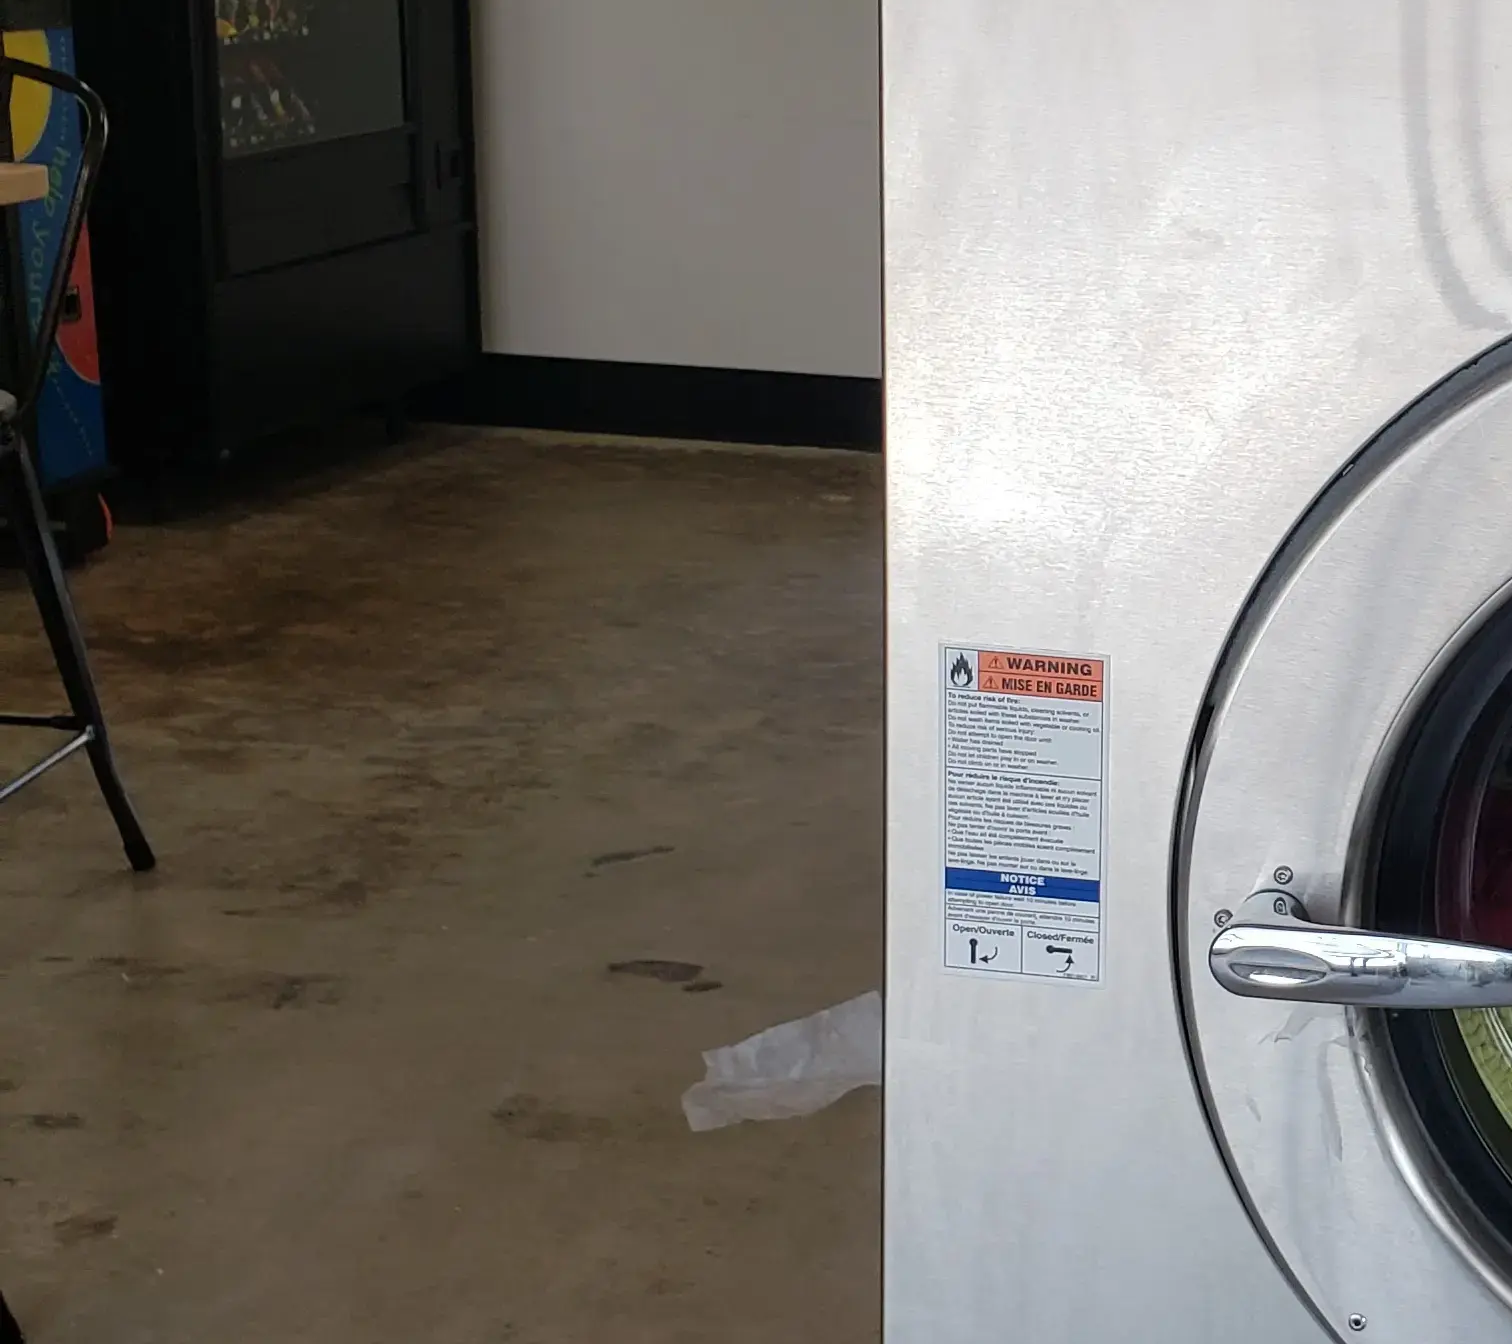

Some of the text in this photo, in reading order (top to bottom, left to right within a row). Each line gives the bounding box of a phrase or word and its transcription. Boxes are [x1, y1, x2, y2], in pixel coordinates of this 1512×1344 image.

[1007, 658, 1091, 676] WARNING
[1002, 677, 1096, 697] MISE EN GARDE
[1001, 873, 1044, 885] NOTICE
[1009, 884, 1035, 895] AVIS
[952, 922, 1014, 938] Open/Ouverte
[1026, 930, 1094, 944] Closed/Fermée
